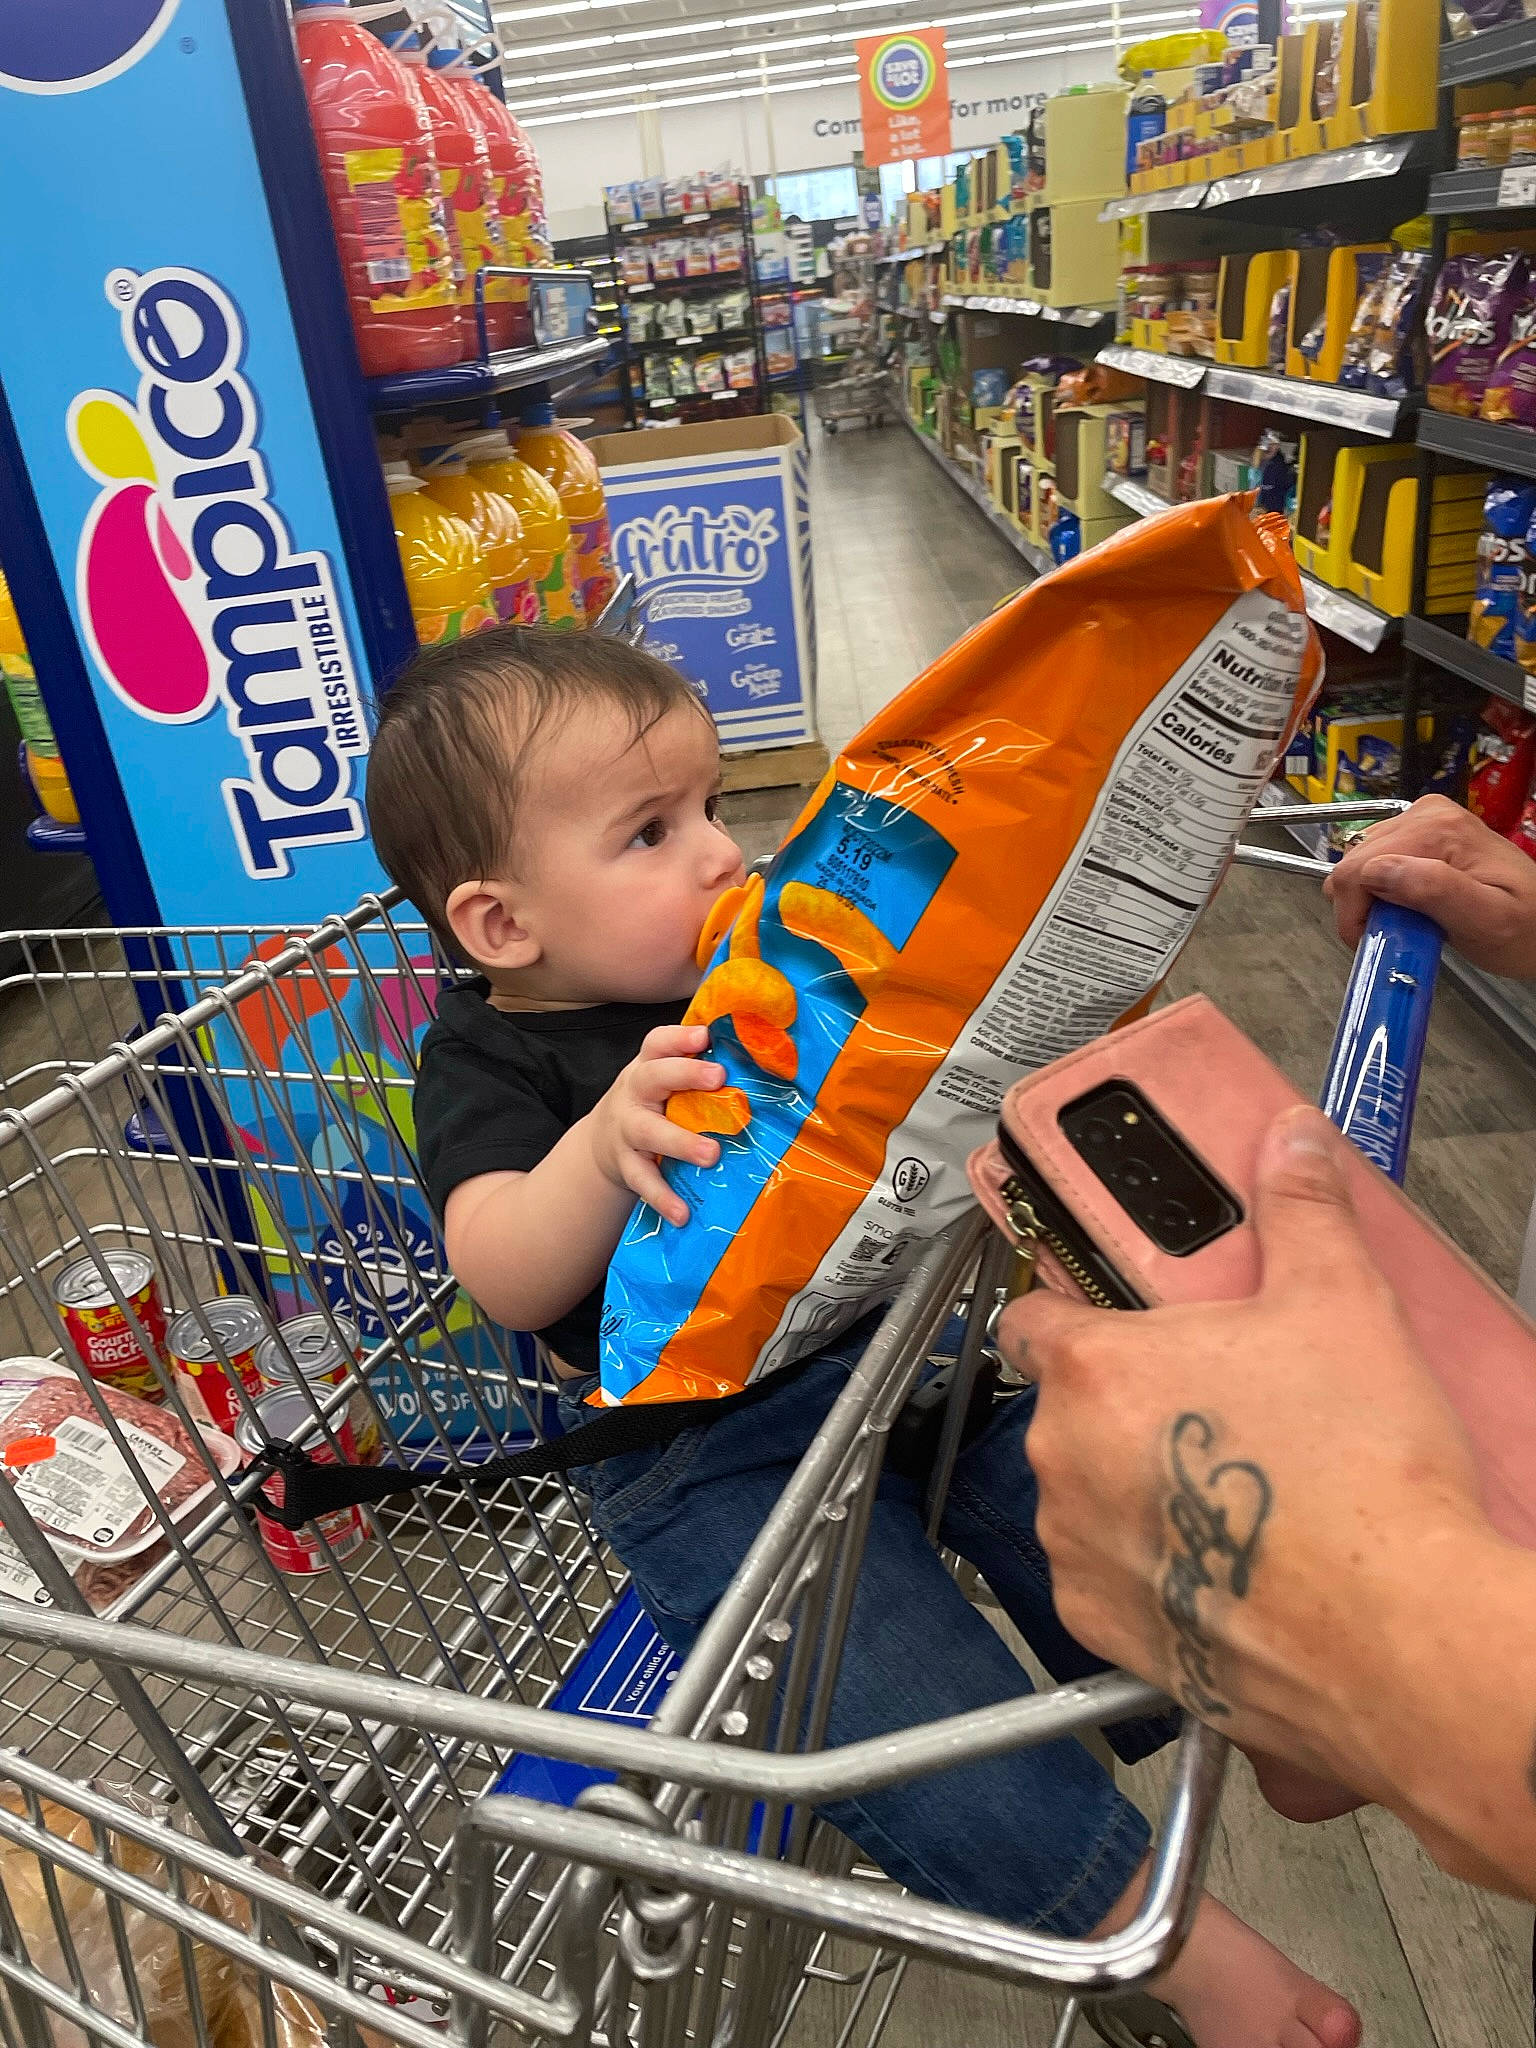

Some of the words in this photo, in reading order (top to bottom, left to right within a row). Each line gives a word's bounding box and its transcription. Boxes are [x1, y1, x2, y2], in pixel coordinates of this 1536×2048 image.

[987, 91, 1048, 114] more
[134, 279, 355, 872] Tampico
[302, 593, 361, 749] IRRESISTIBLE
[1188, 679, 1226, 709] Serving
[1161, 711, 1236, 765] Calories
[1137, 743, 1163, 764] Total
[1161, 759, 1180, 775] Fat
[1115, 780, 1165, 813] Cholesterol
[1119, 814, 1180, 851] Carbohydrate
[837, 836, 873, 871] 5.19
[324, 1222, 384, 1257] 00%
[86, 1319, 151, 1350] Gourmt
[625, 1680, 646, 1703] Your
[642, 1656, 662, 1680] child
